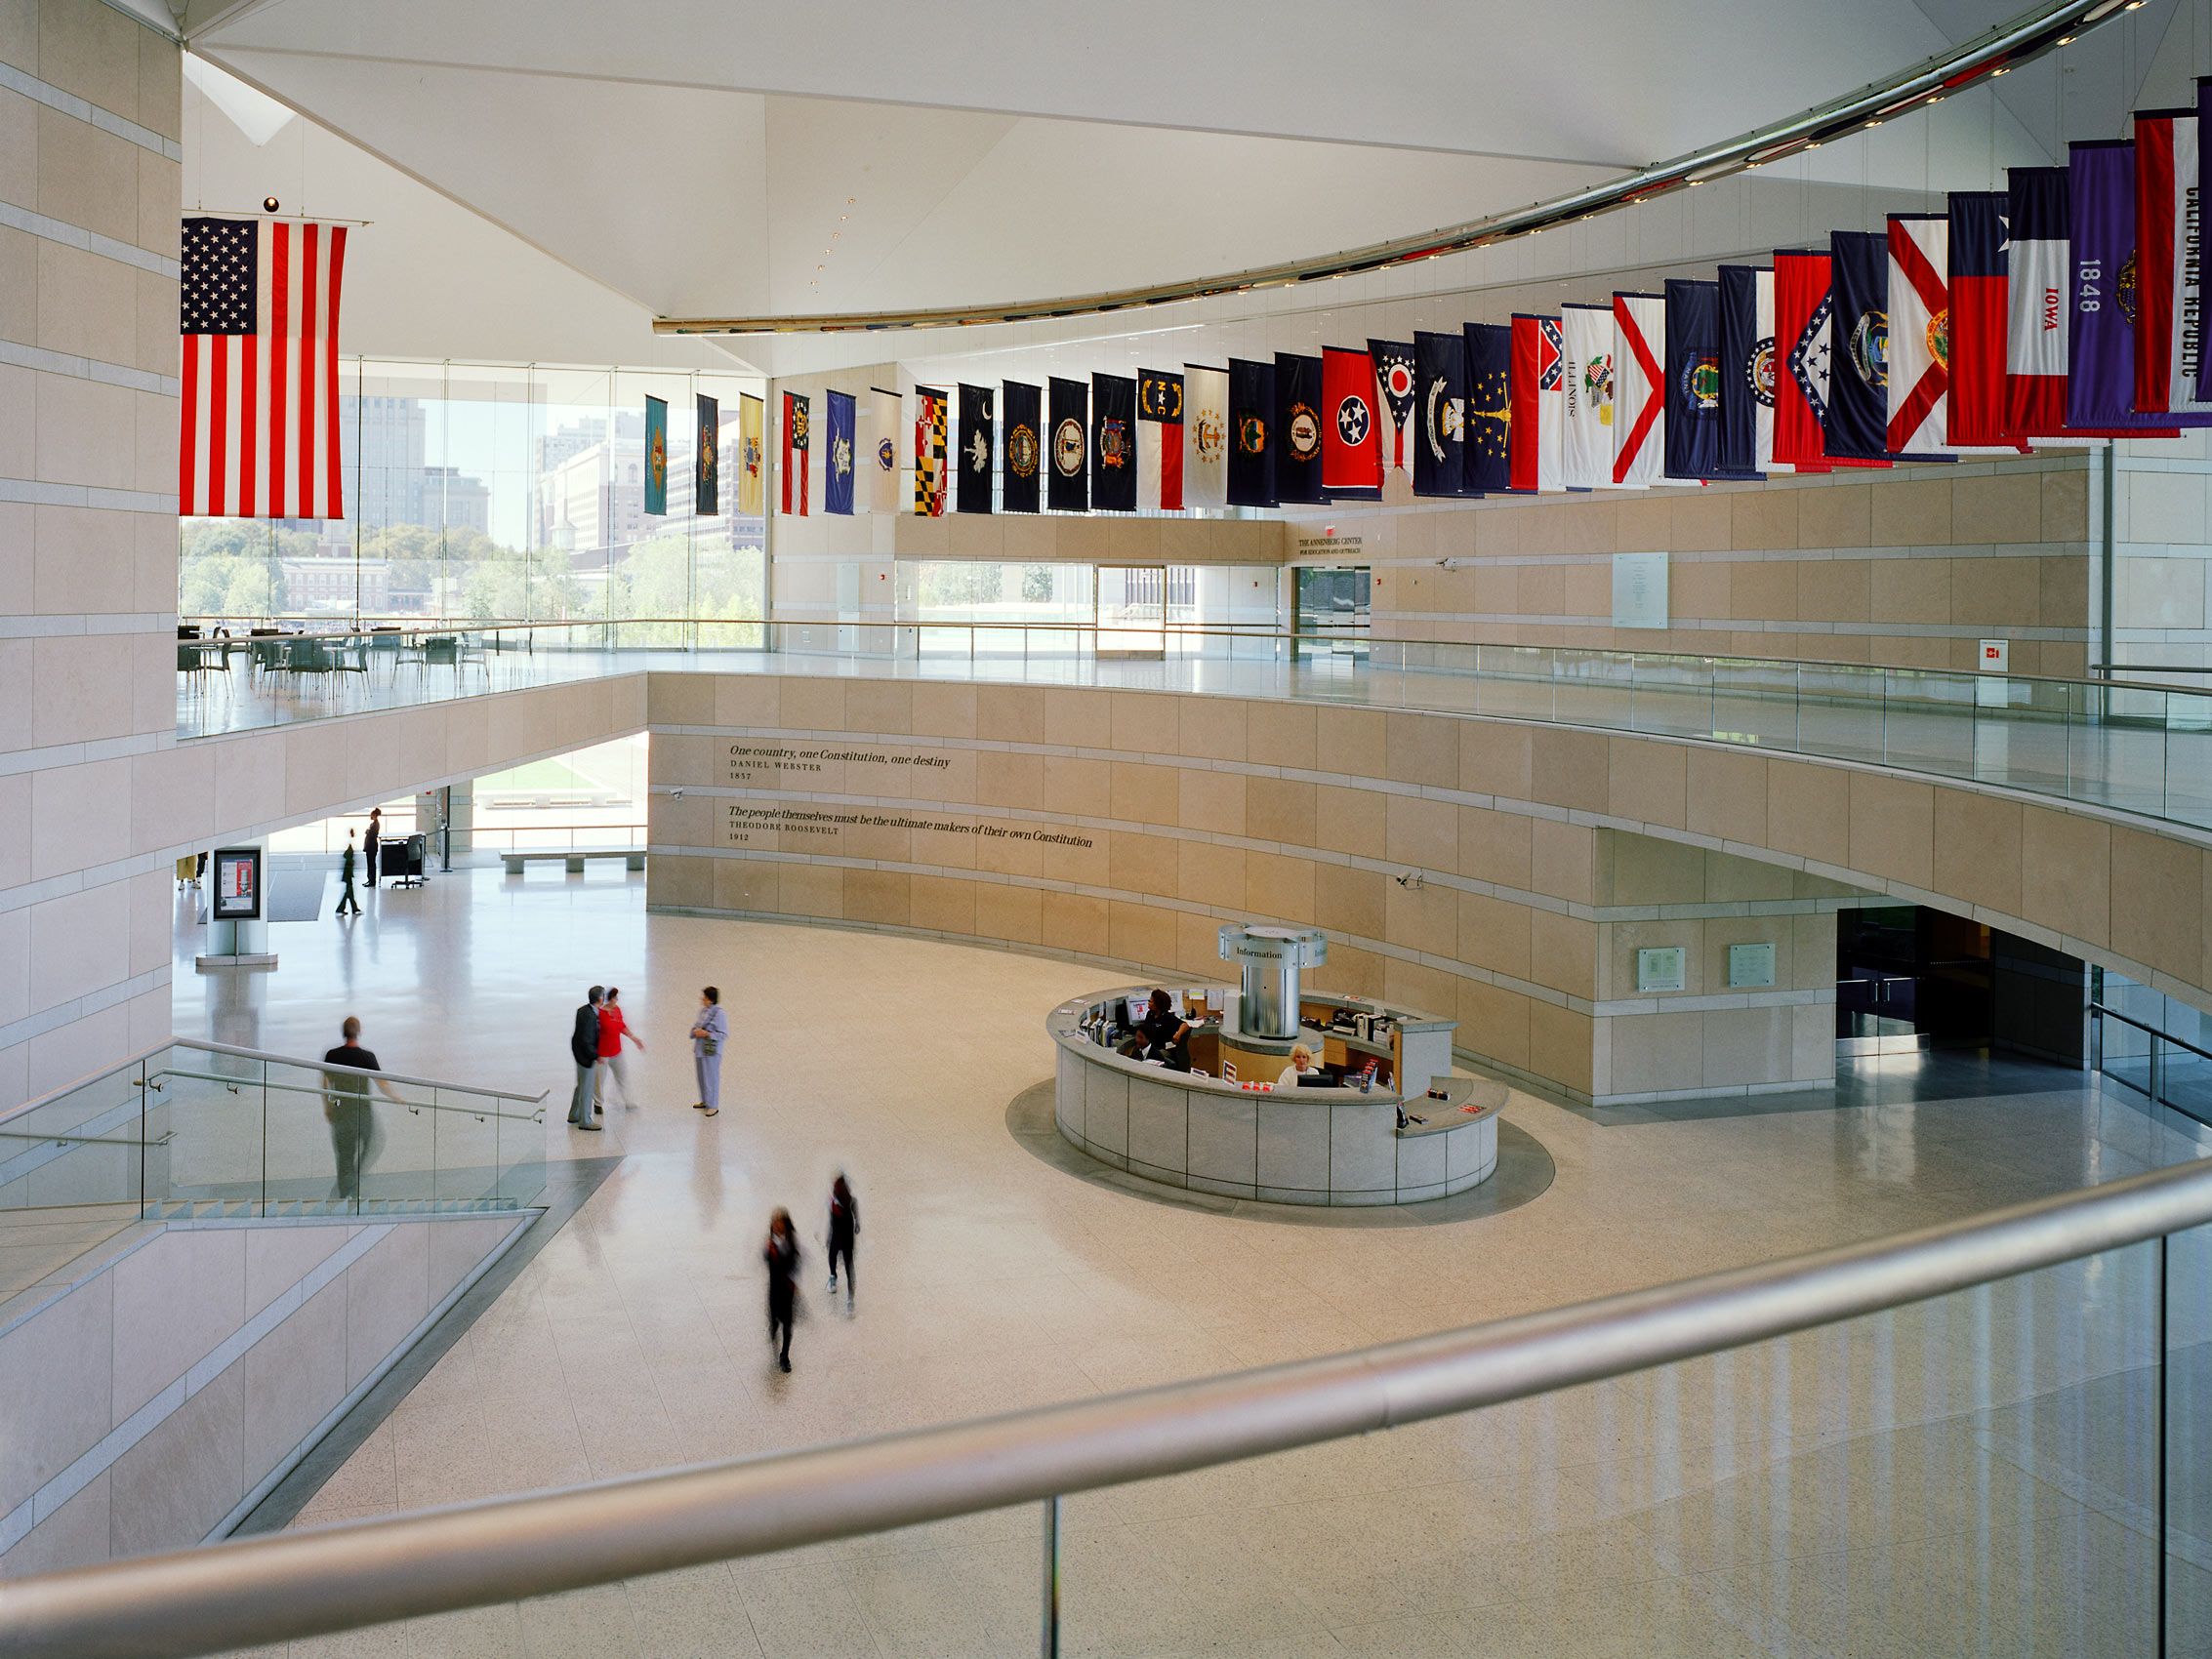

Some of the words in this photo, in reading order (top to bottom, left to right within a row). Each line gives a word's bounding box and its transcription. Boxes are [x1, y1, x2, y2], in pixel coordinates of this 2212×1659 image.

[2079, 259, 2101, 311] 1848
[2044, 288, 2059, 331] IOWA
[1158, 381, 1166, 390] N
[1568, 361, 1577, 417] ILLINOIS
[1157, 406, 1166, 415] C
[730, 745, 752, 755] One
[753, 749, 797, 760] country,
[820, 749, 888, 764] Constitution,
[890, 755, 912, 765] one
[913, 755, 952, 770] destiny
[730, 759, 770, 769] DANIEL
[774, 761, 822, 772] WEBSTER
[729, 805, 749, 816] The
[748, 808, 781, 820] people
[781, 809, 834, 823] themselves
[834, 814, 859, 824] must
[859, 814, 873, 825] be
[873, 816, 889, 827] the
[889, 817, 933, 830] ultimate
[933, 821, 970, 833] makers
[971, 825, 984, 834] of
[984, 826, 1008, 837] their
[1009, 830, 1032, 840] own
[1033, 830, 1093, 848] Constitution
[729, 821, 781, 830] THEODORE
[785, 824, 839, 835] ROOSEVELT
[1236, 947, 1283, 959] Information
